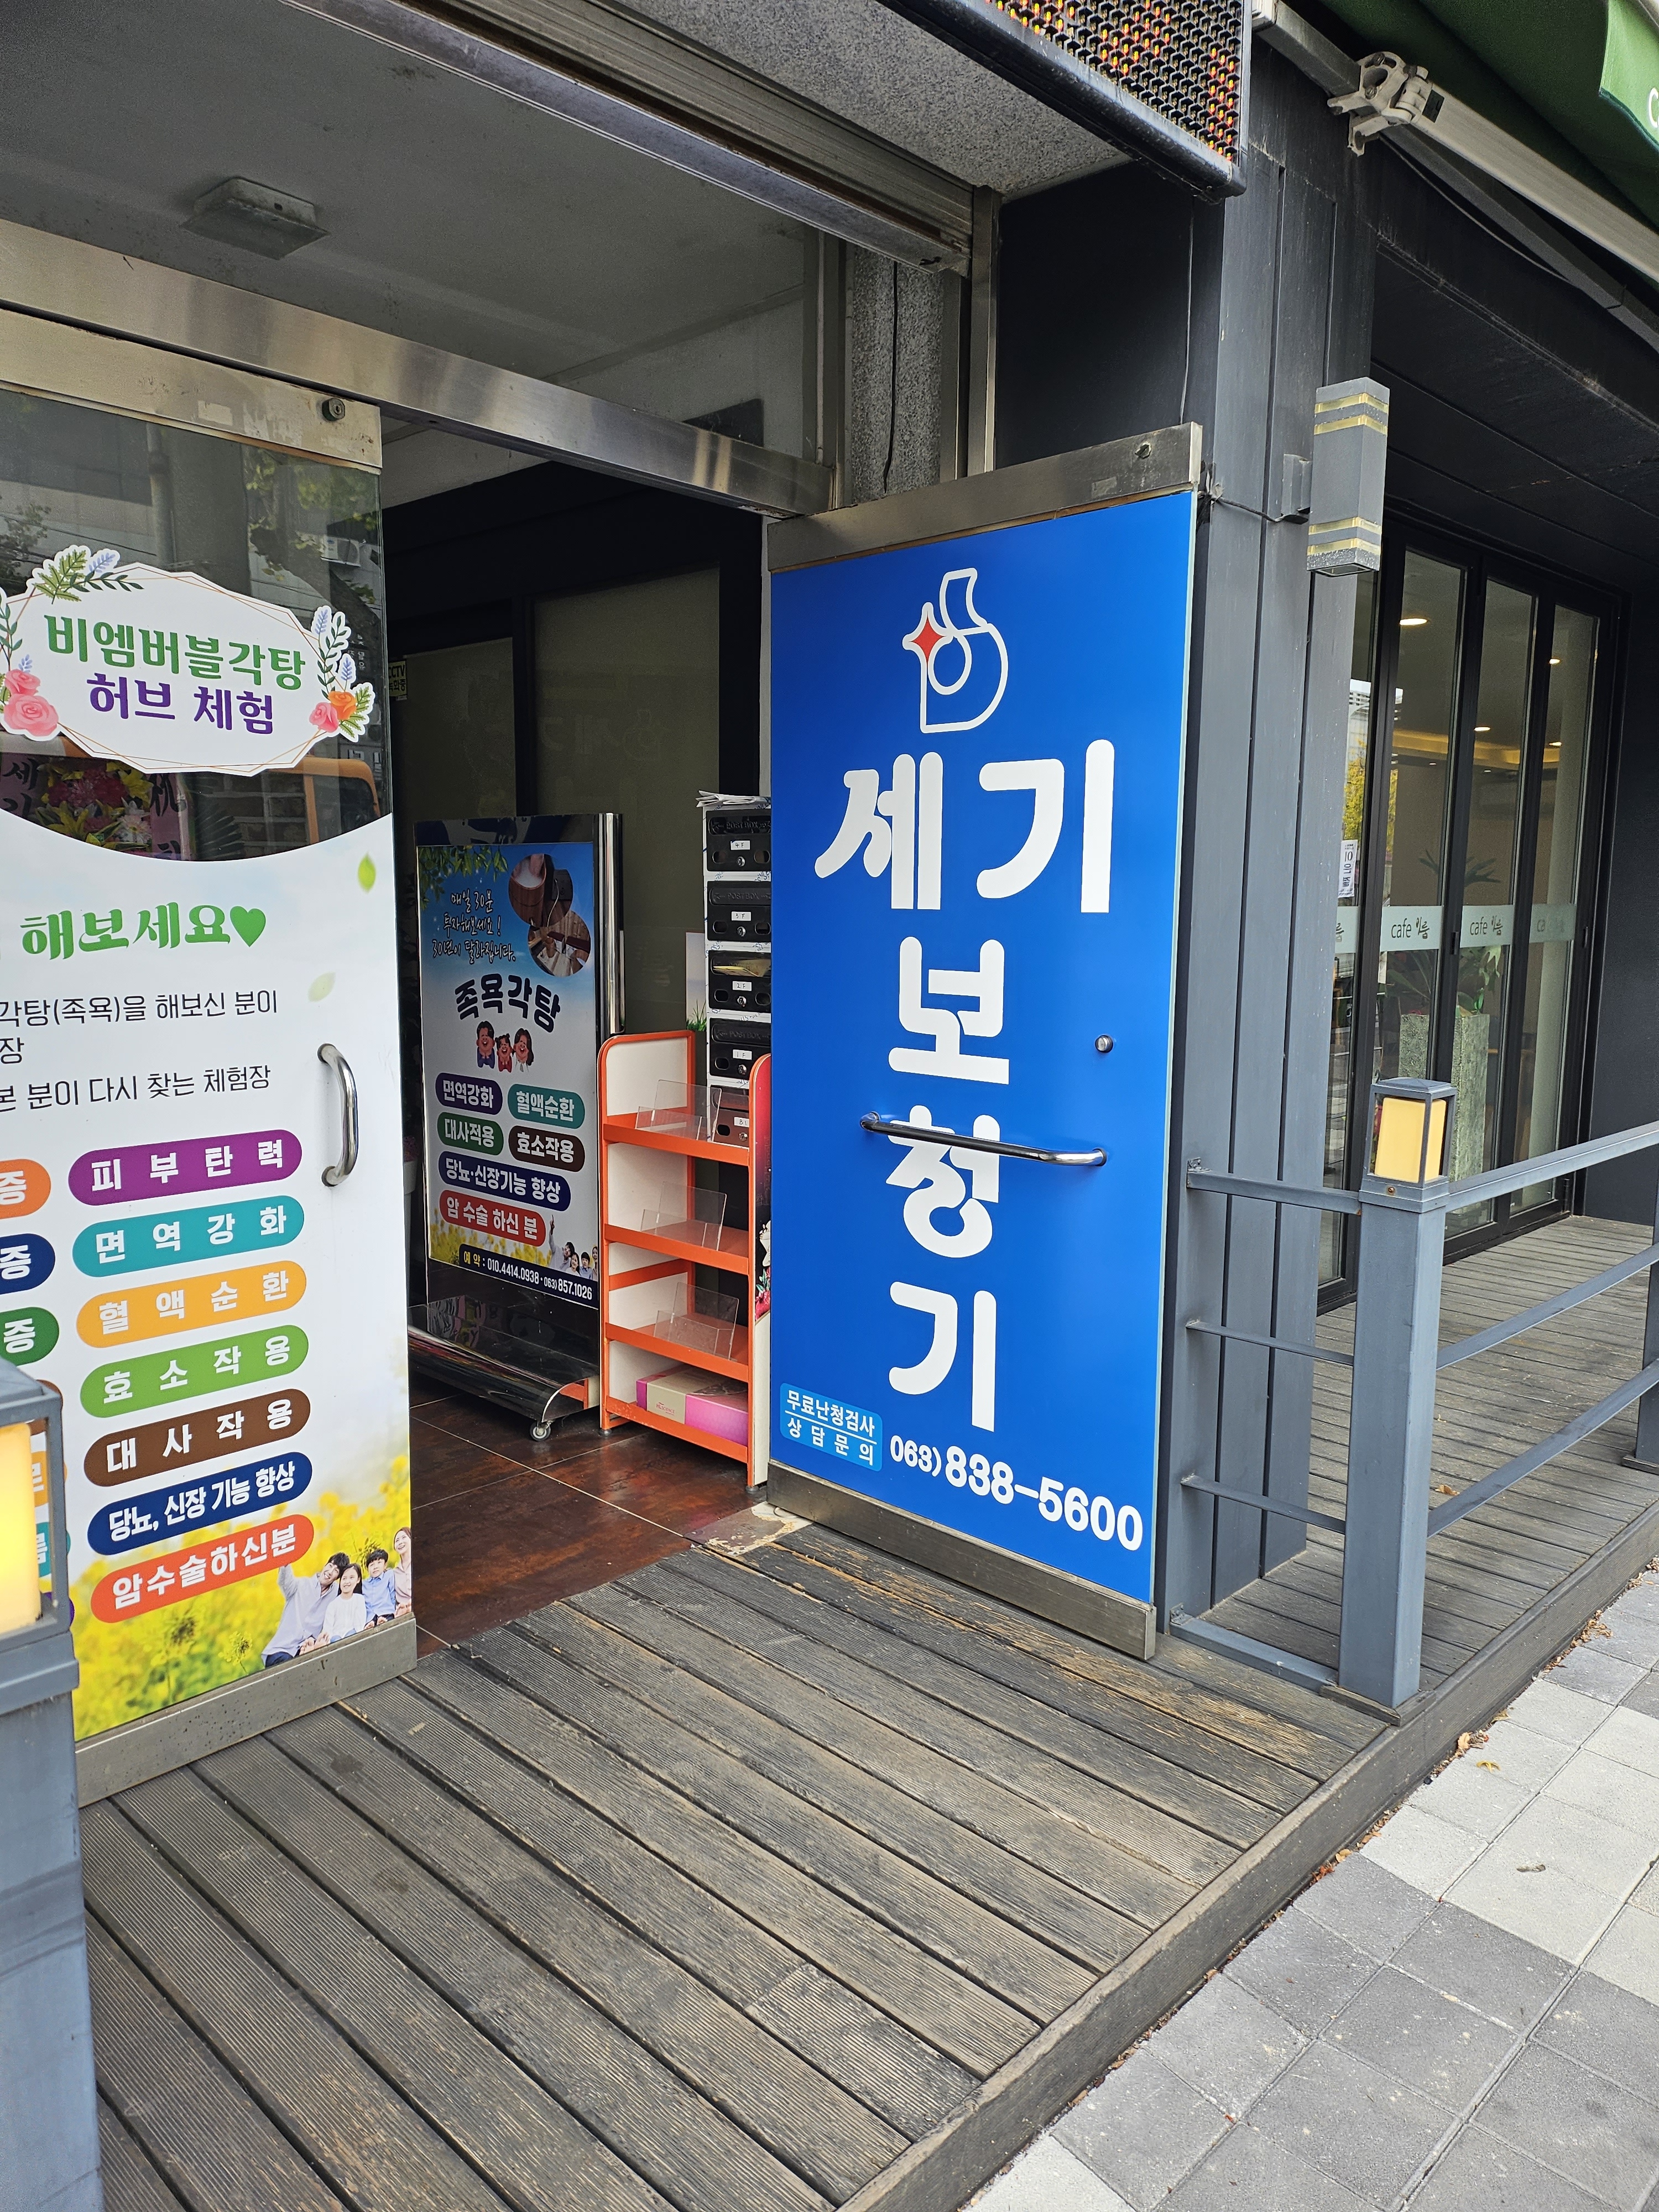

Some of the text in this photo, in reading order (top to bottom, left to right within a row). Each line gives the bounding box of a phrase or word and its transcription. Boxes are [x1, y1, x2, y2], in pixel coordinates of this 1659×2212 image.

[44, 614, 306, 691] 비엠버블각탕
[86, 672, 274, 735] 허브 체험
[814, 739, 1115, 914] 세기
[451, 888, 493, 913] 매일 30분
[20, 902, 231, 960] 해보세요
[1391, 918, 1411, 938] cafe
[1470, 916, 1488, 935] cafe
[432, 940, 516, 964] 30년이 달라집니다.
[155, 992, 226, 1020] 해보신
[234, 990, 278, 1015] 분이
[455, 973, 561, 1032] 족욕각탕
[0, 1037, 24, 1065] 장
[28, 1079, 79, 1109] 분이
[90, 1076, 138, 1103] 다시
[148, 1073, 195, 1099] 찾는
[204, 1065, 272, 1093] 체험장
[442, 1080, 494, 1108] 면역강화
[516, 1091, 575, 1121] 혈액순환
[444, 1118, 494, 1147] 대사적용
[517, 1132, 575, 1163] 효소작용
[531, 1177, 561, 1203] 향상
[447, 1197, 538, 1240] 암 수술 하신 분
[0, 1245, 32, 1280] 증
[3, 1318, 35, 1354] 증
[786, 1390, 875, 1438] 무료난청검사
[109, 1460, 295, 1543] 당뇨, 신장 기능 향상
